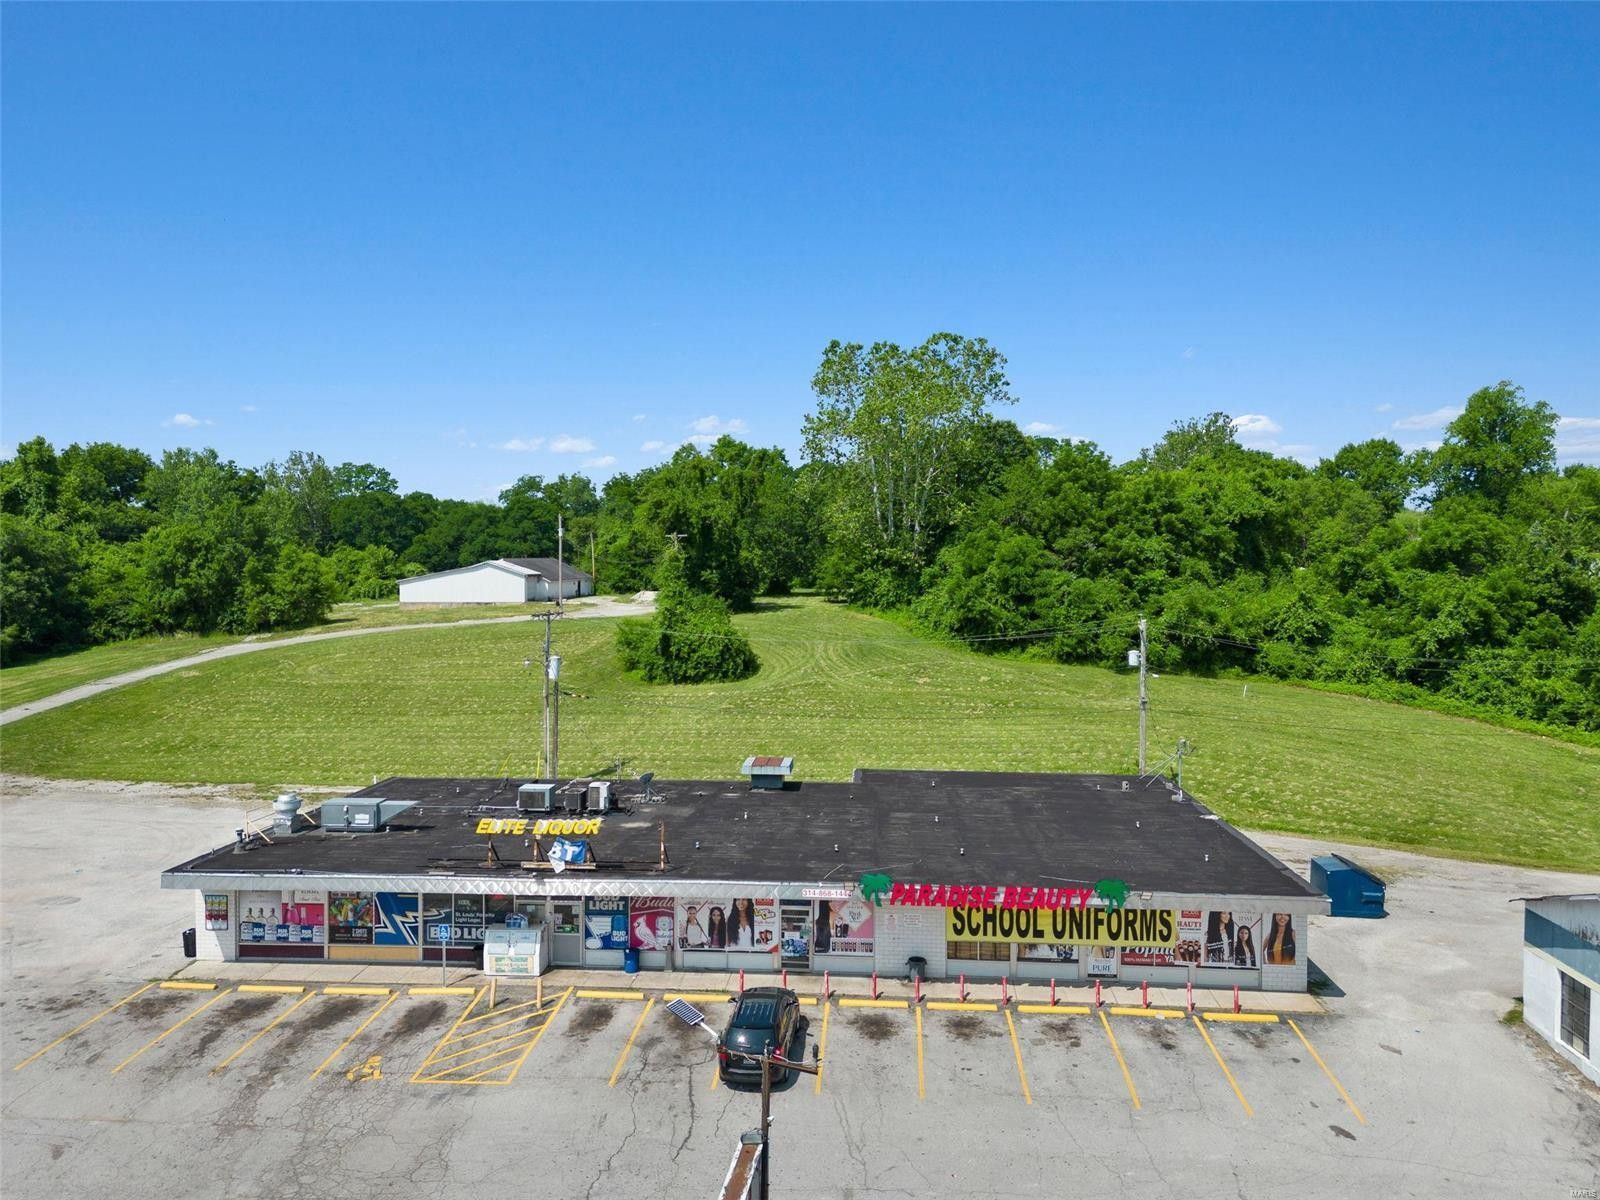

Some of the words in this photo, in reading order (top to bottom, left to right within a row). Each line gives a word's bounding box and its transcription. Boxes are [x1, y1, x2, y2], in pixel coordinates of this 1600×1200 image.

[476, 818, 529, 835] ELITE
[532, 818, 602, 835] LIQUOR
[889, 882, 998, 909] PARADISE
[1002, 886, 1095, 912] BEAUTY
[588, 901, 625, 911] LIGHT
[952, 904, 1044, 939] SCHOOL
[1052, 907, 1173, 943] UNIFORMS
[430, 927, 461, 939] BD
